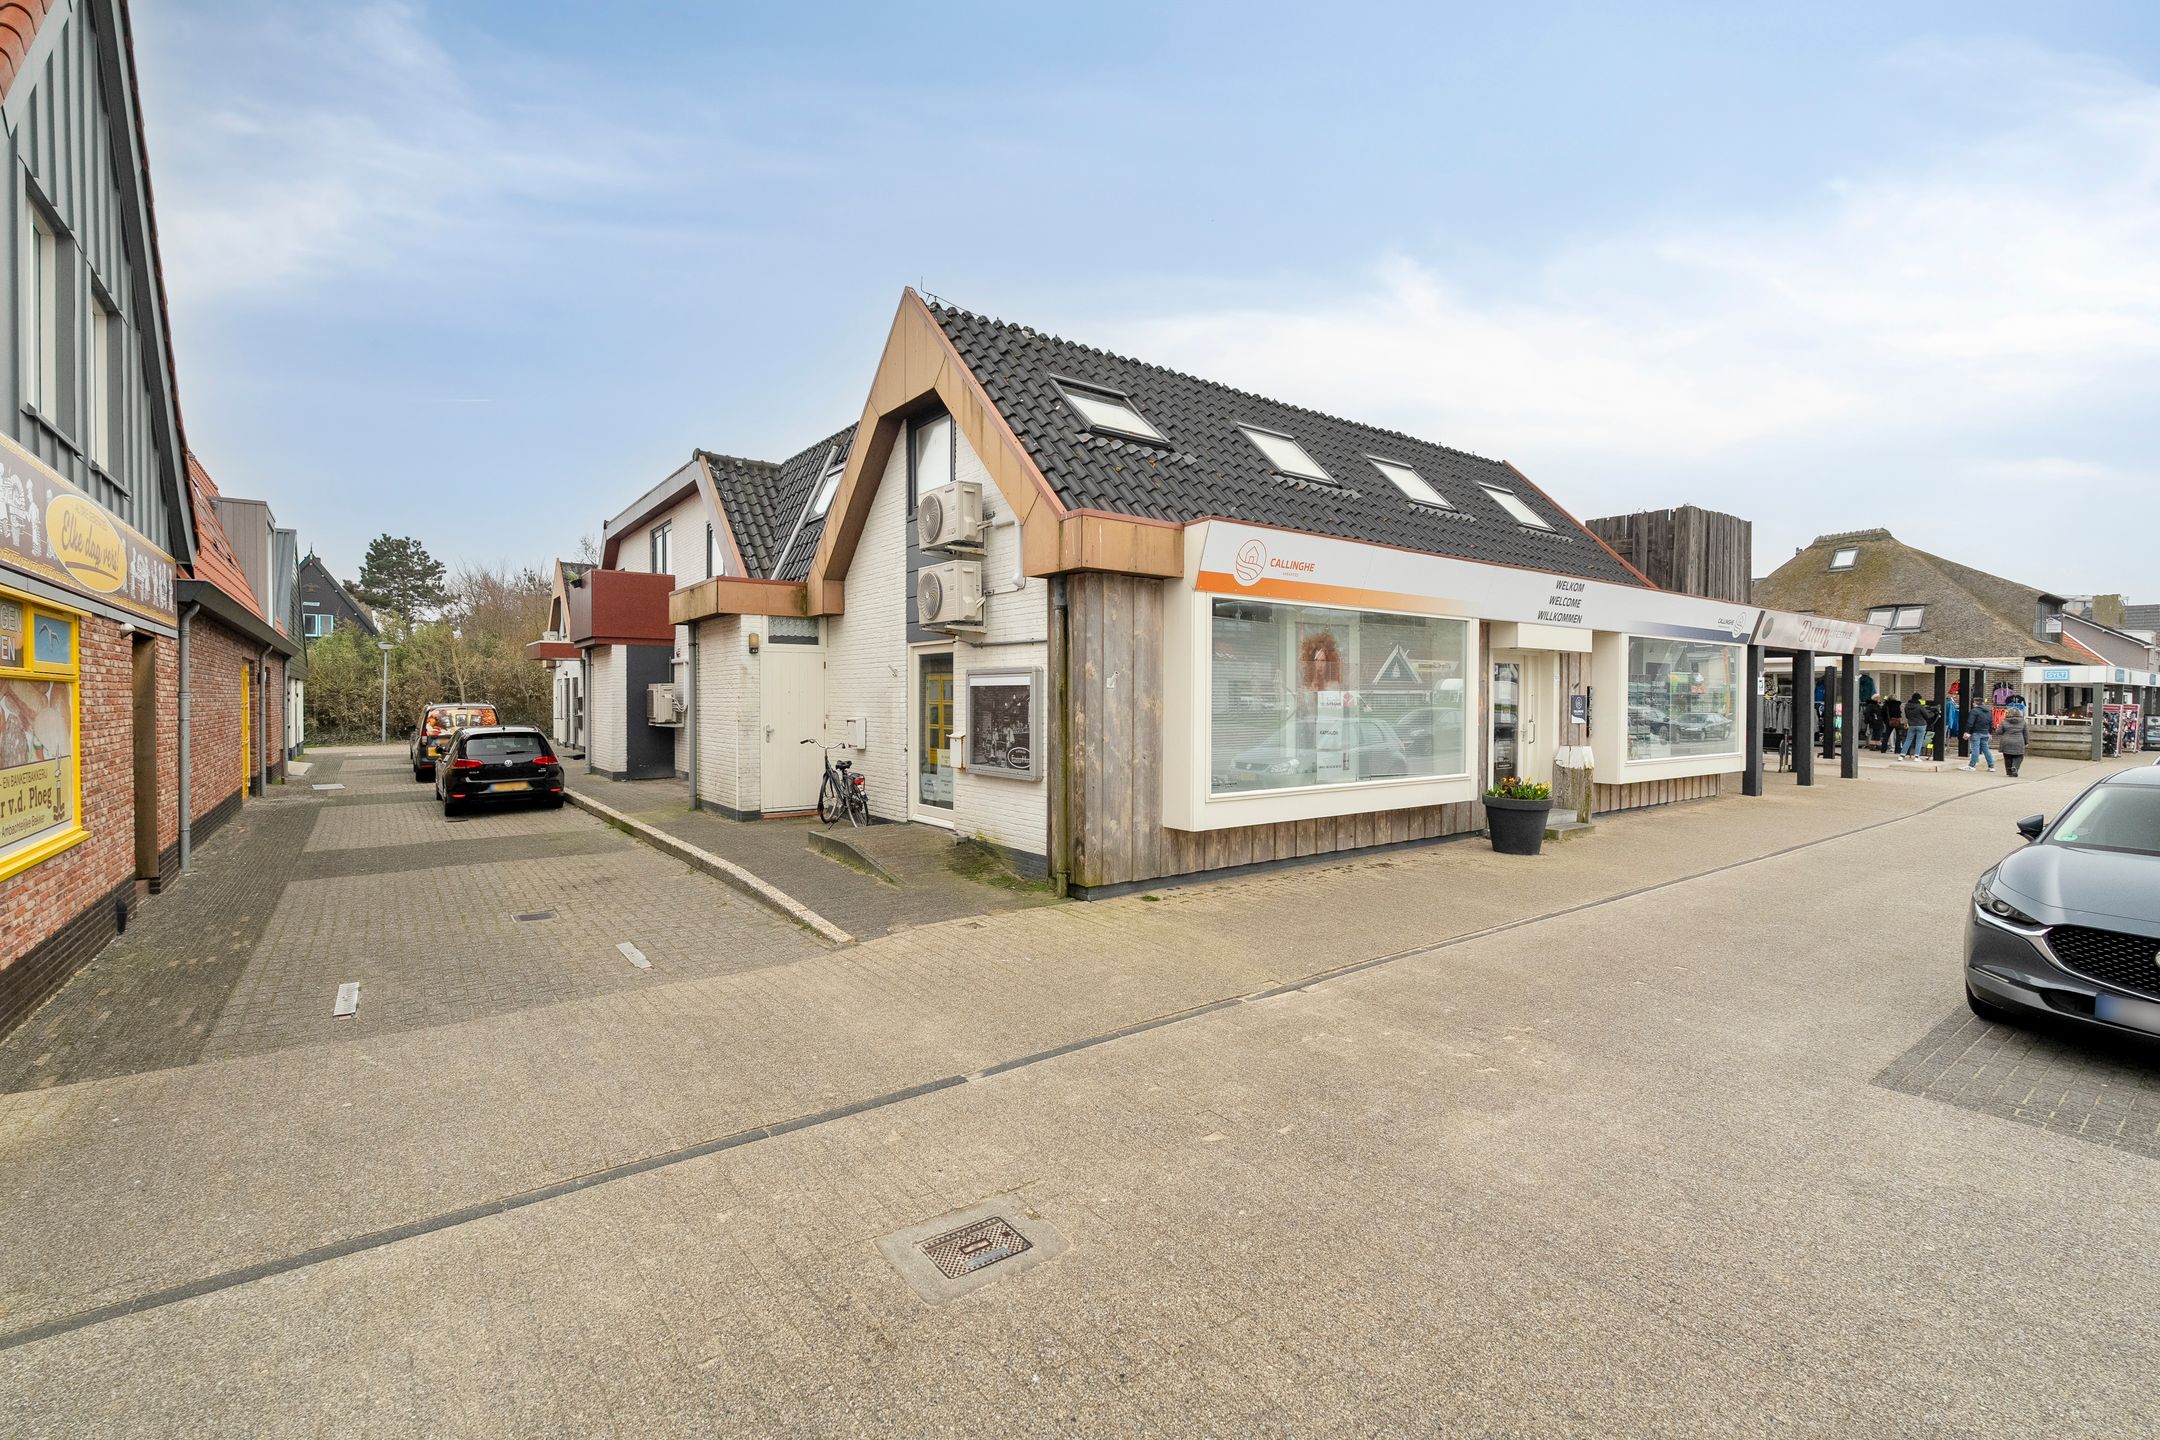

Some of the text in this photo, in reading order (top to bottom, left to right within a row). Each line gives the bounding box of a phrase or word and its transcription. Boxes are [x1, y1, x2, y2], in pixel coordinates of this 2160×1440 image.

[62, 509, 84, 553] Elke
[85, 523, 102, 568] dag
[1269, 558, 1316, 572] CALLINGHE
[1555, 579, 1585, 592] WELKOM
[1549, 595, 1582, 608] WELCOME
[1537, 610, 1583, 624] WILLKOMMEN
[29, 785, 53, 809] Ploeg
